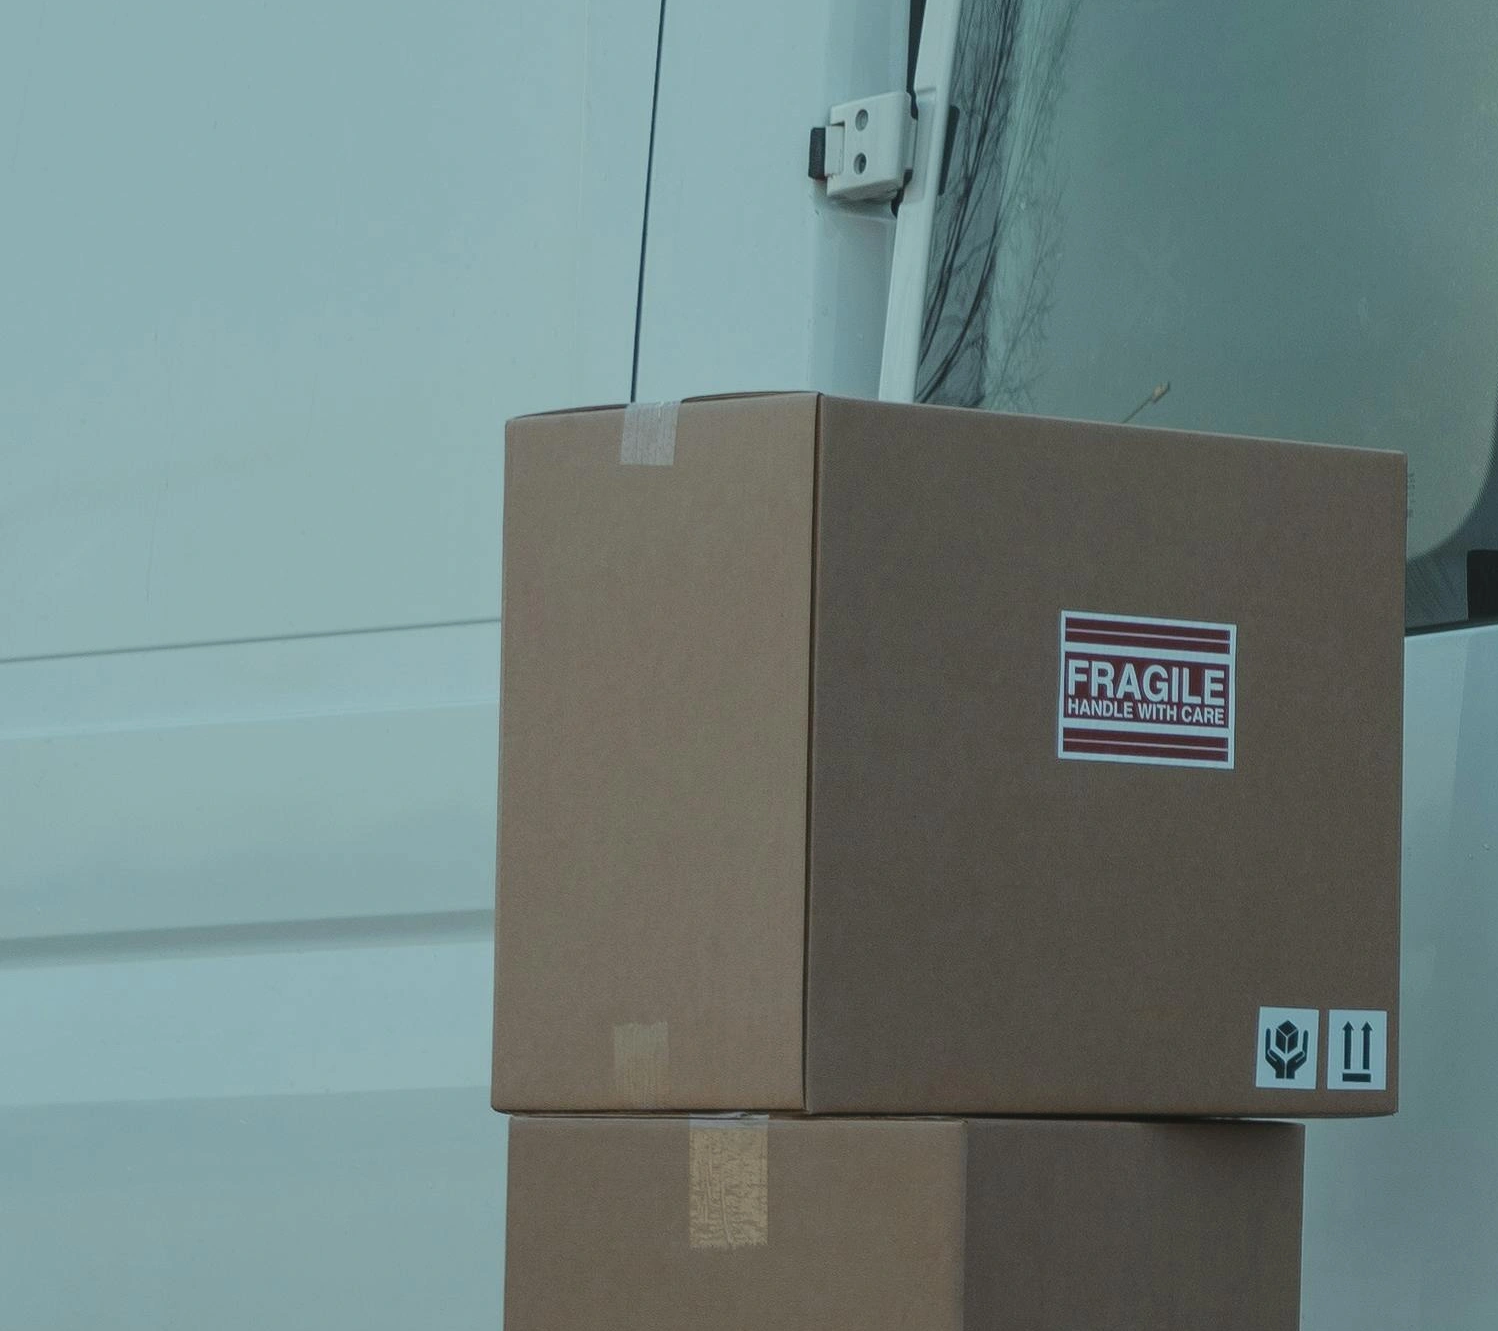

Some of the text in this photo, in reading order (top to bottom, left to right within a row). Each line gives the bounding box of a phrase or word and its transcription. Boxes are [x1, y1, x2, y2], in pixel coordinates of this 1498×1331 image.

[1068, 659, 1225, 706] FRAGILE
[1068, 697, 1224, 725] HANDLE WITH CARE
